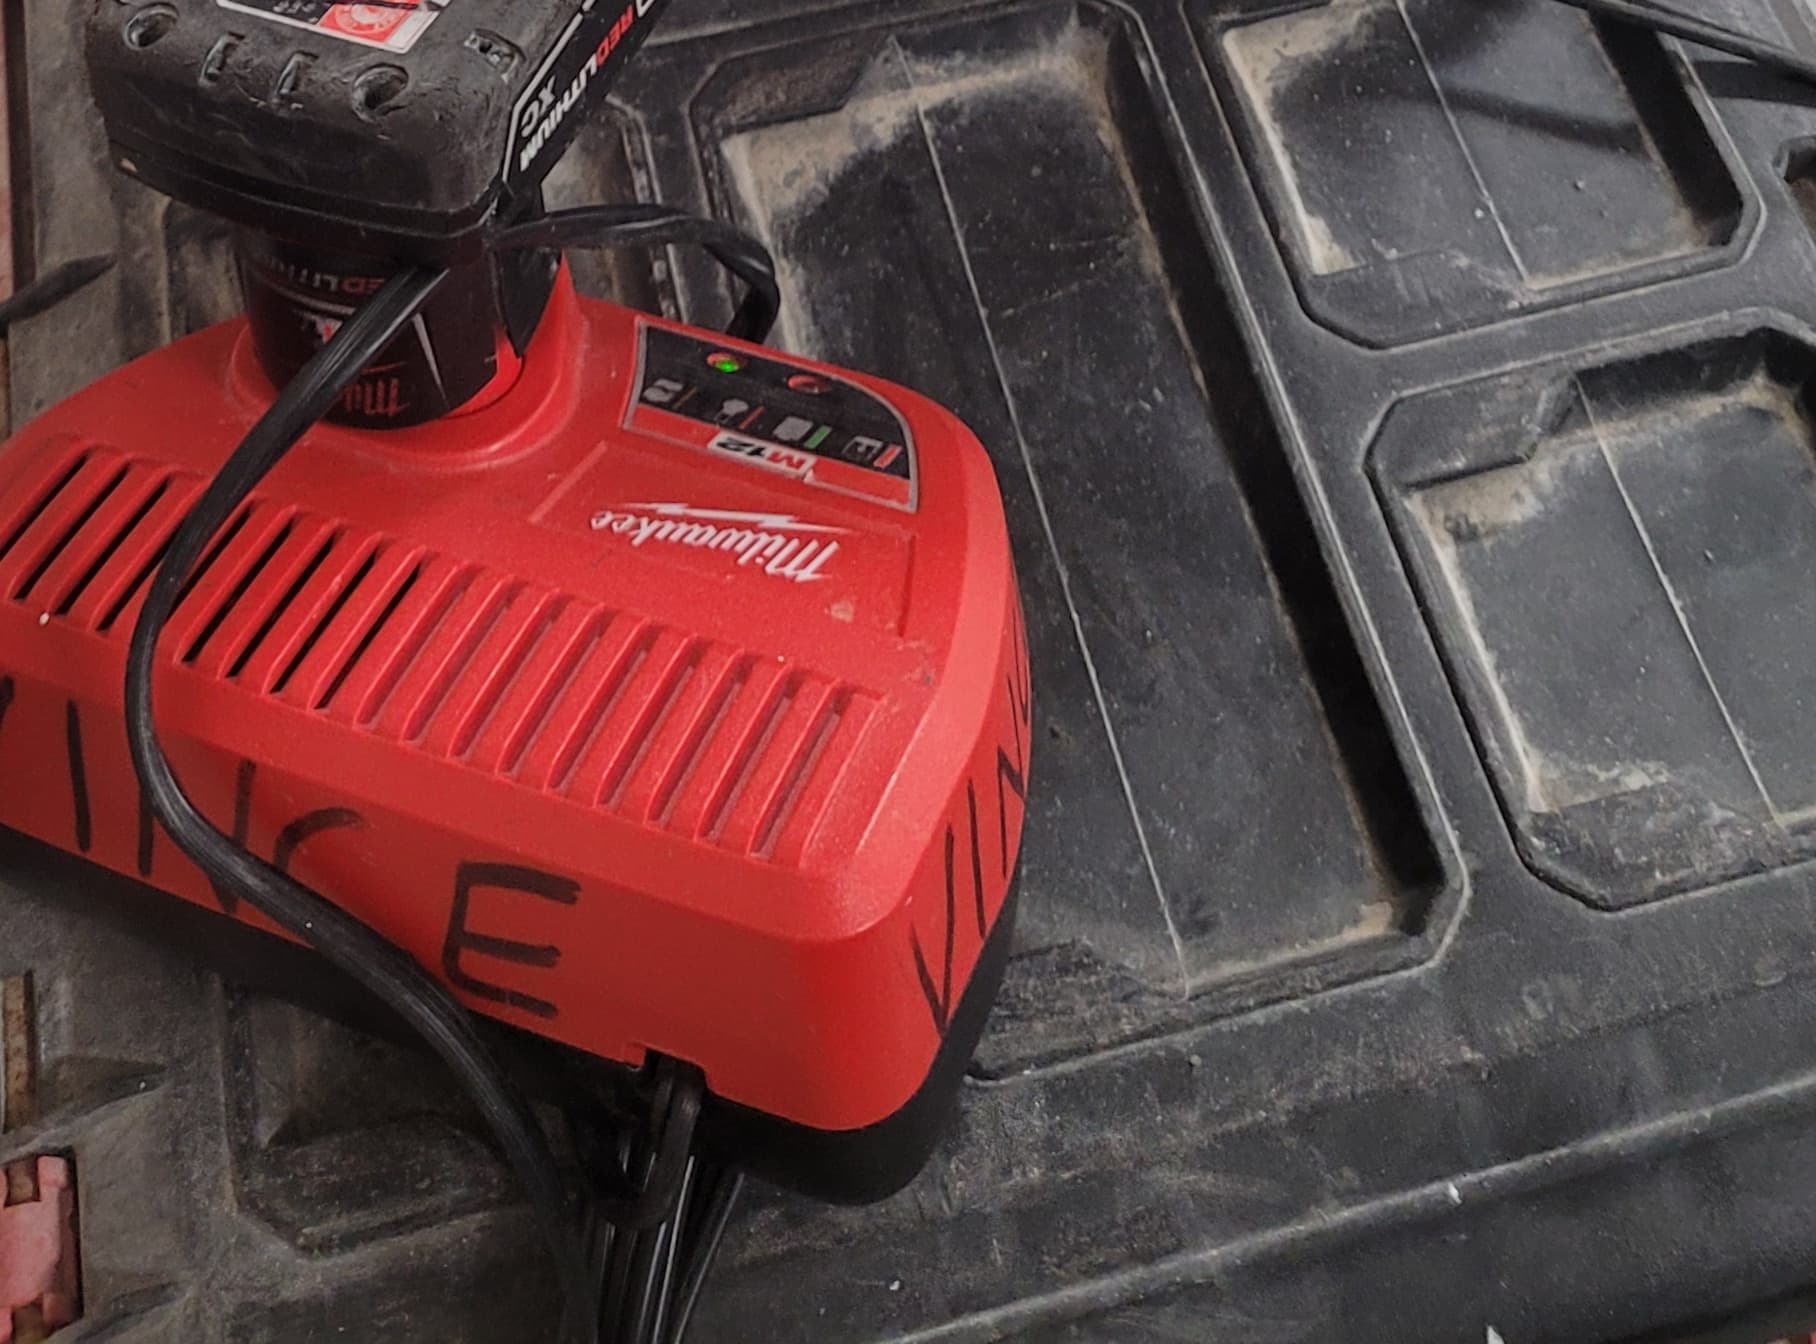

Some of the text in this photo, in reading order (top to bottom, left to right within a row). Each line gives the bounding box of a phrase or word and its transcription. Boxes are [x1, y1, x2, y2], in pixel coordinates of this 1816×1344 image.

[521, 75, 556, 139] XC
[716, 436, 808, 469] M12
[590, 510, 839, 582] Milwaukee
[0, 674, 582, 1018] INCE
